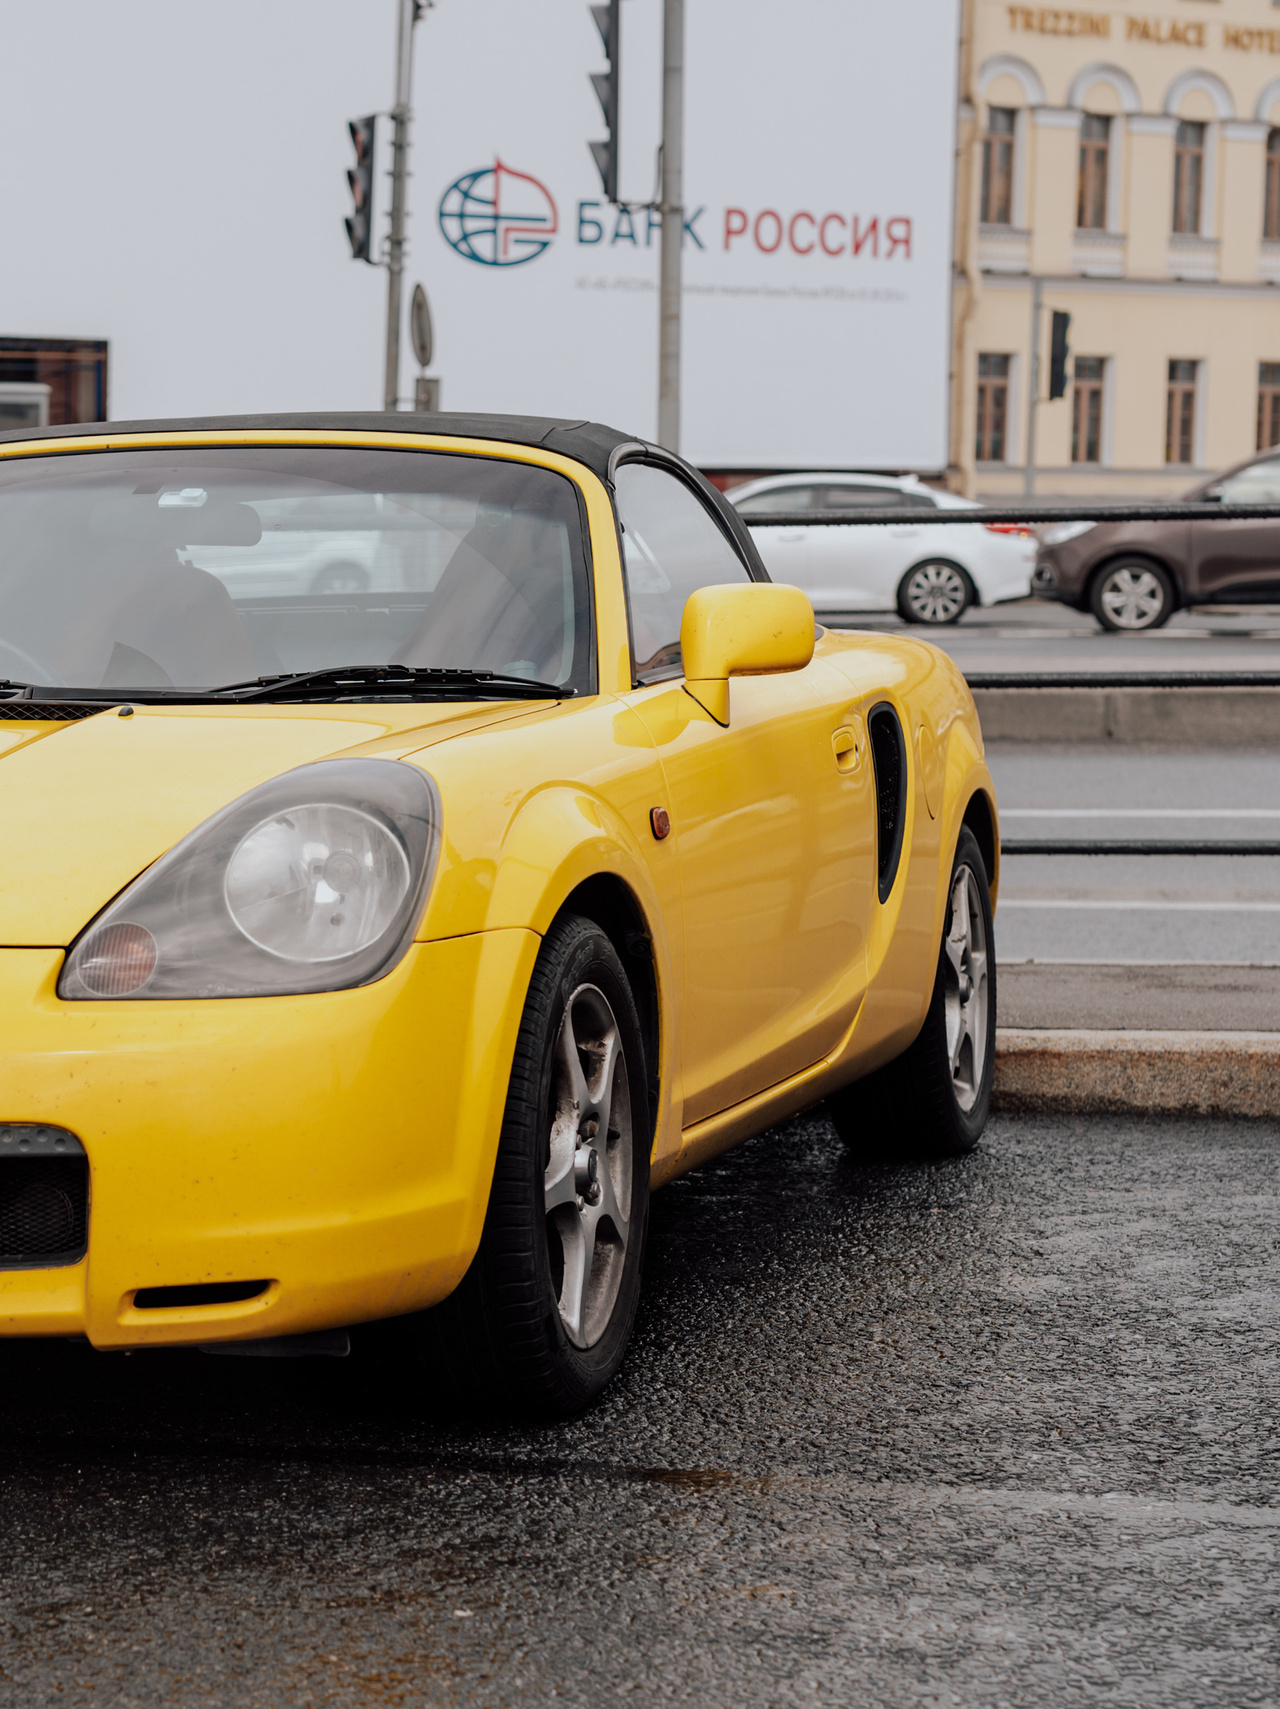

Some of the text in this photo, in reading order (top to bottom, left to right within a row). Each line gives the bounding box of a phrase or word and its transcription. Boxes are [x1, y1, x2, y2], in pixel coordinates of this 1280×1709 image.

[1007, 6, 1111, 39] TREZZINI
[1125, 15, 1206, 48] PALACE
[723, 207, 913, 260] РОССИЯ
